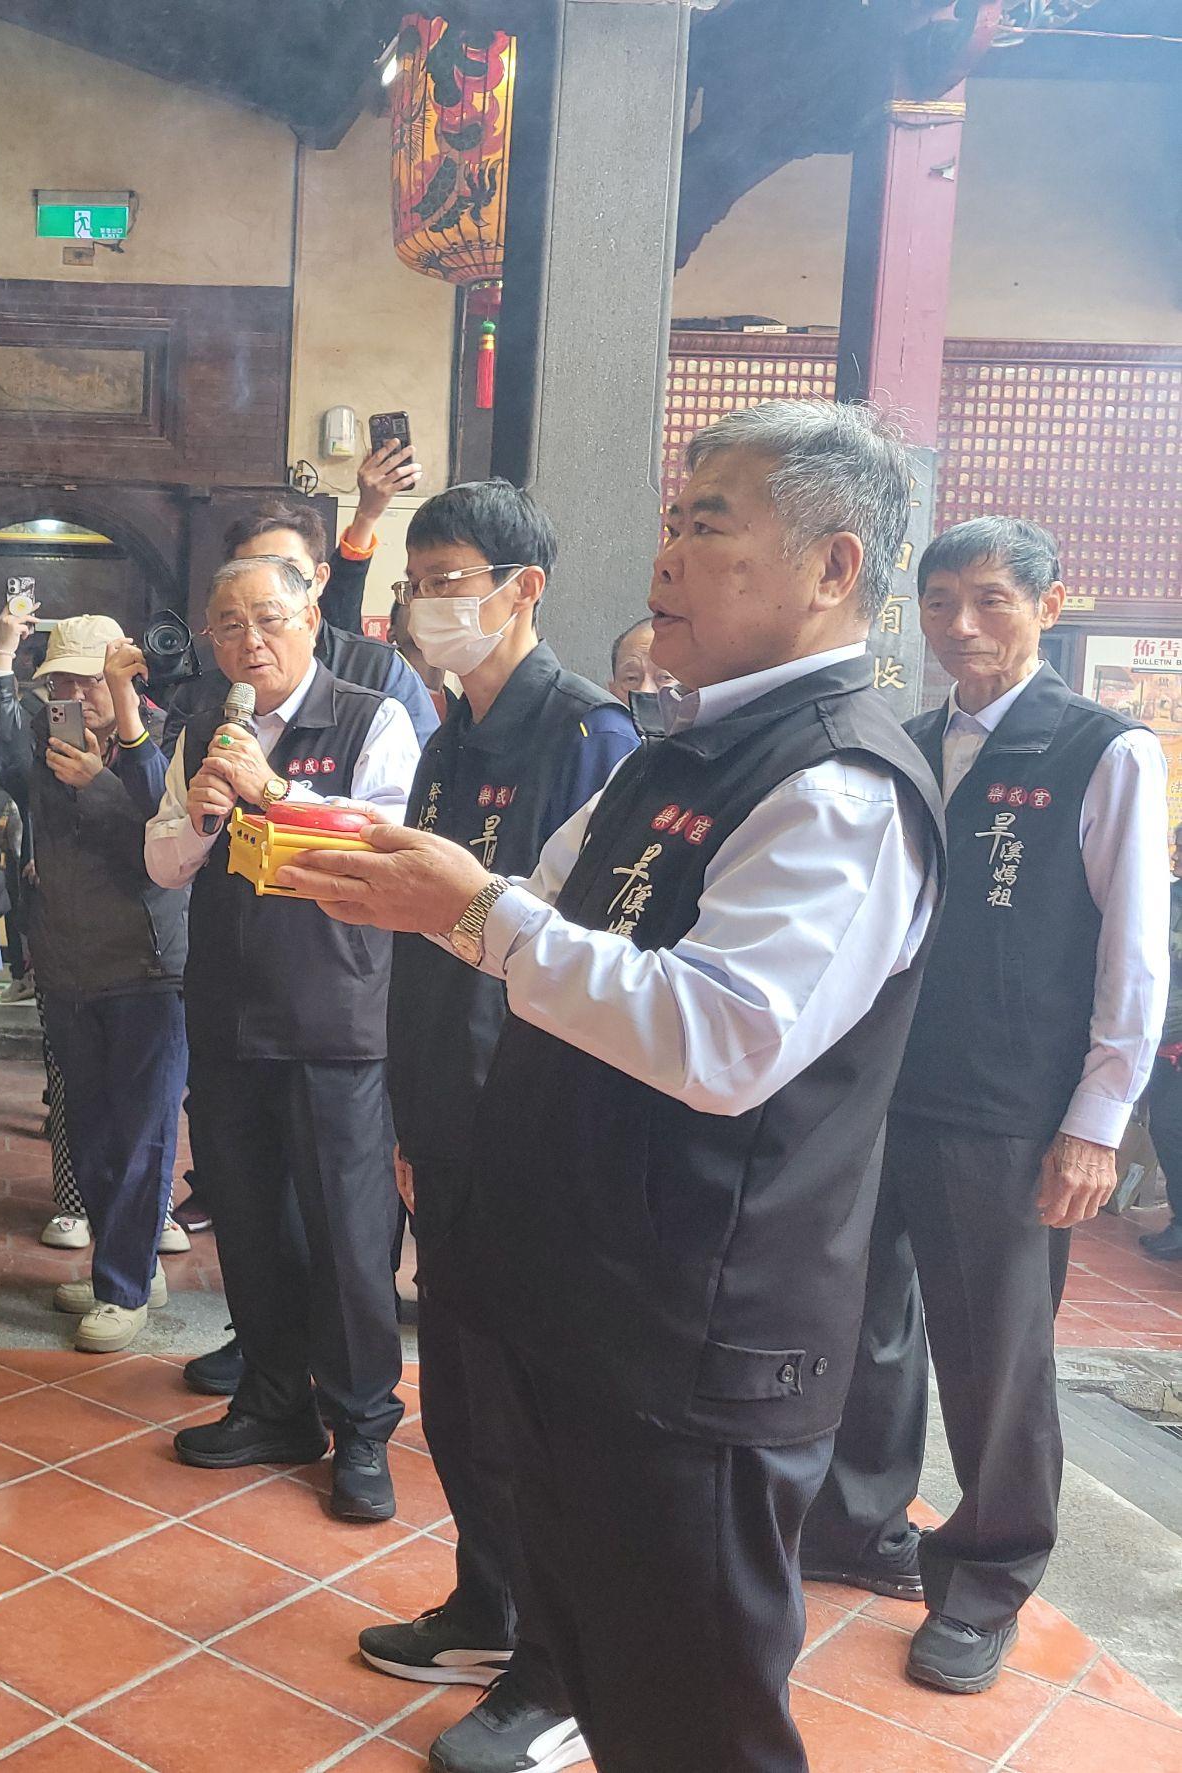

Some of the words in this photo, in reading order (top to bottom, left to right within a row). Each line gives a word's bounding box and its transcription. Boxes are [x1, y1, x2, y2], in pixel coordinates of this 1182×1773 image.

[1133, 658, 1172, 666] BULLETIN
[478, 784, 518, 808] 樂成
[987, 785, 1050, 806] 樂成宮
[653, 806, 712, 843] 樂宮
[974, 812, 1025, 908] 旱溪媽祖
